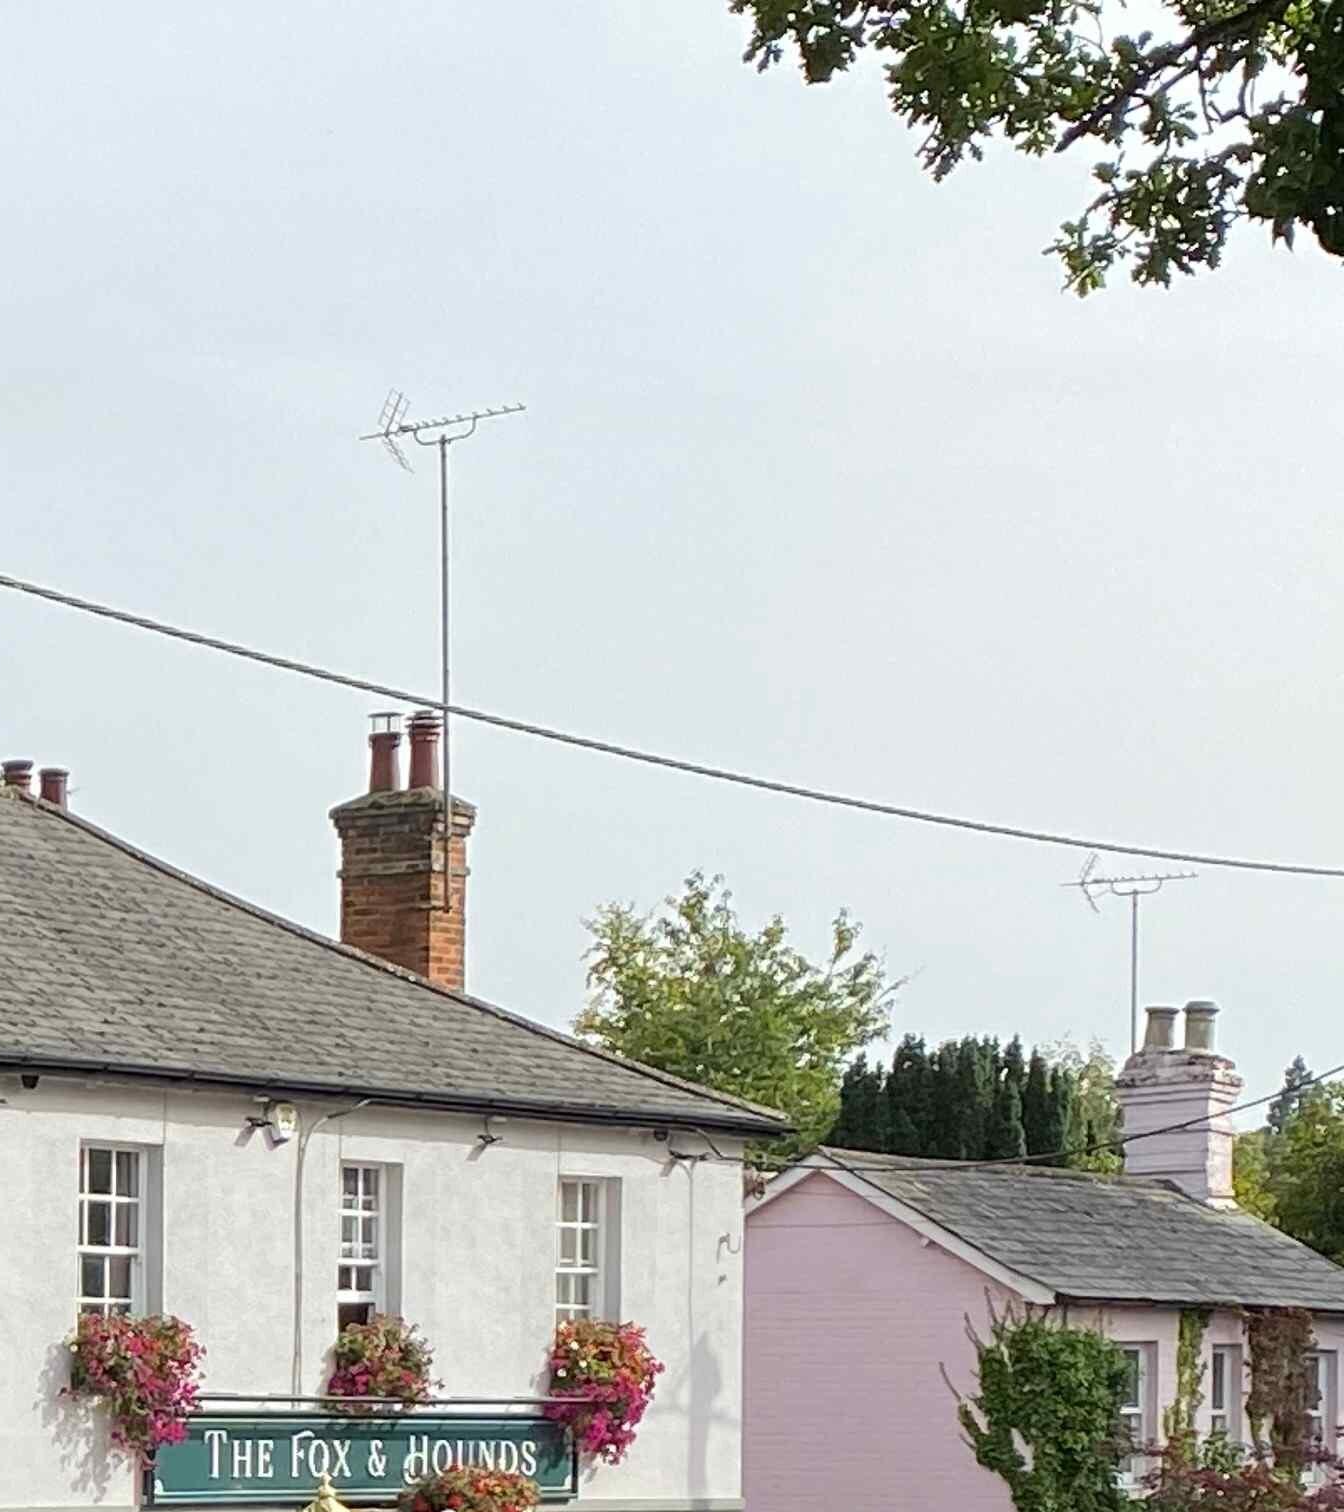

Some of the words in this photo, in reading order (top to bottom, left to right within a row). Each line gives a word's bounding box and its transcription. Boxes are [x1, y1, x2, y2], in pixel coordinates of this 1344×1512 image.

[204, 1429, 274, 1479] THE
[290, 1430, 352, 1479] FOX
[367, 1439, 387, 1476] &
[403, 1434, 538, 1485] HOUNDS
